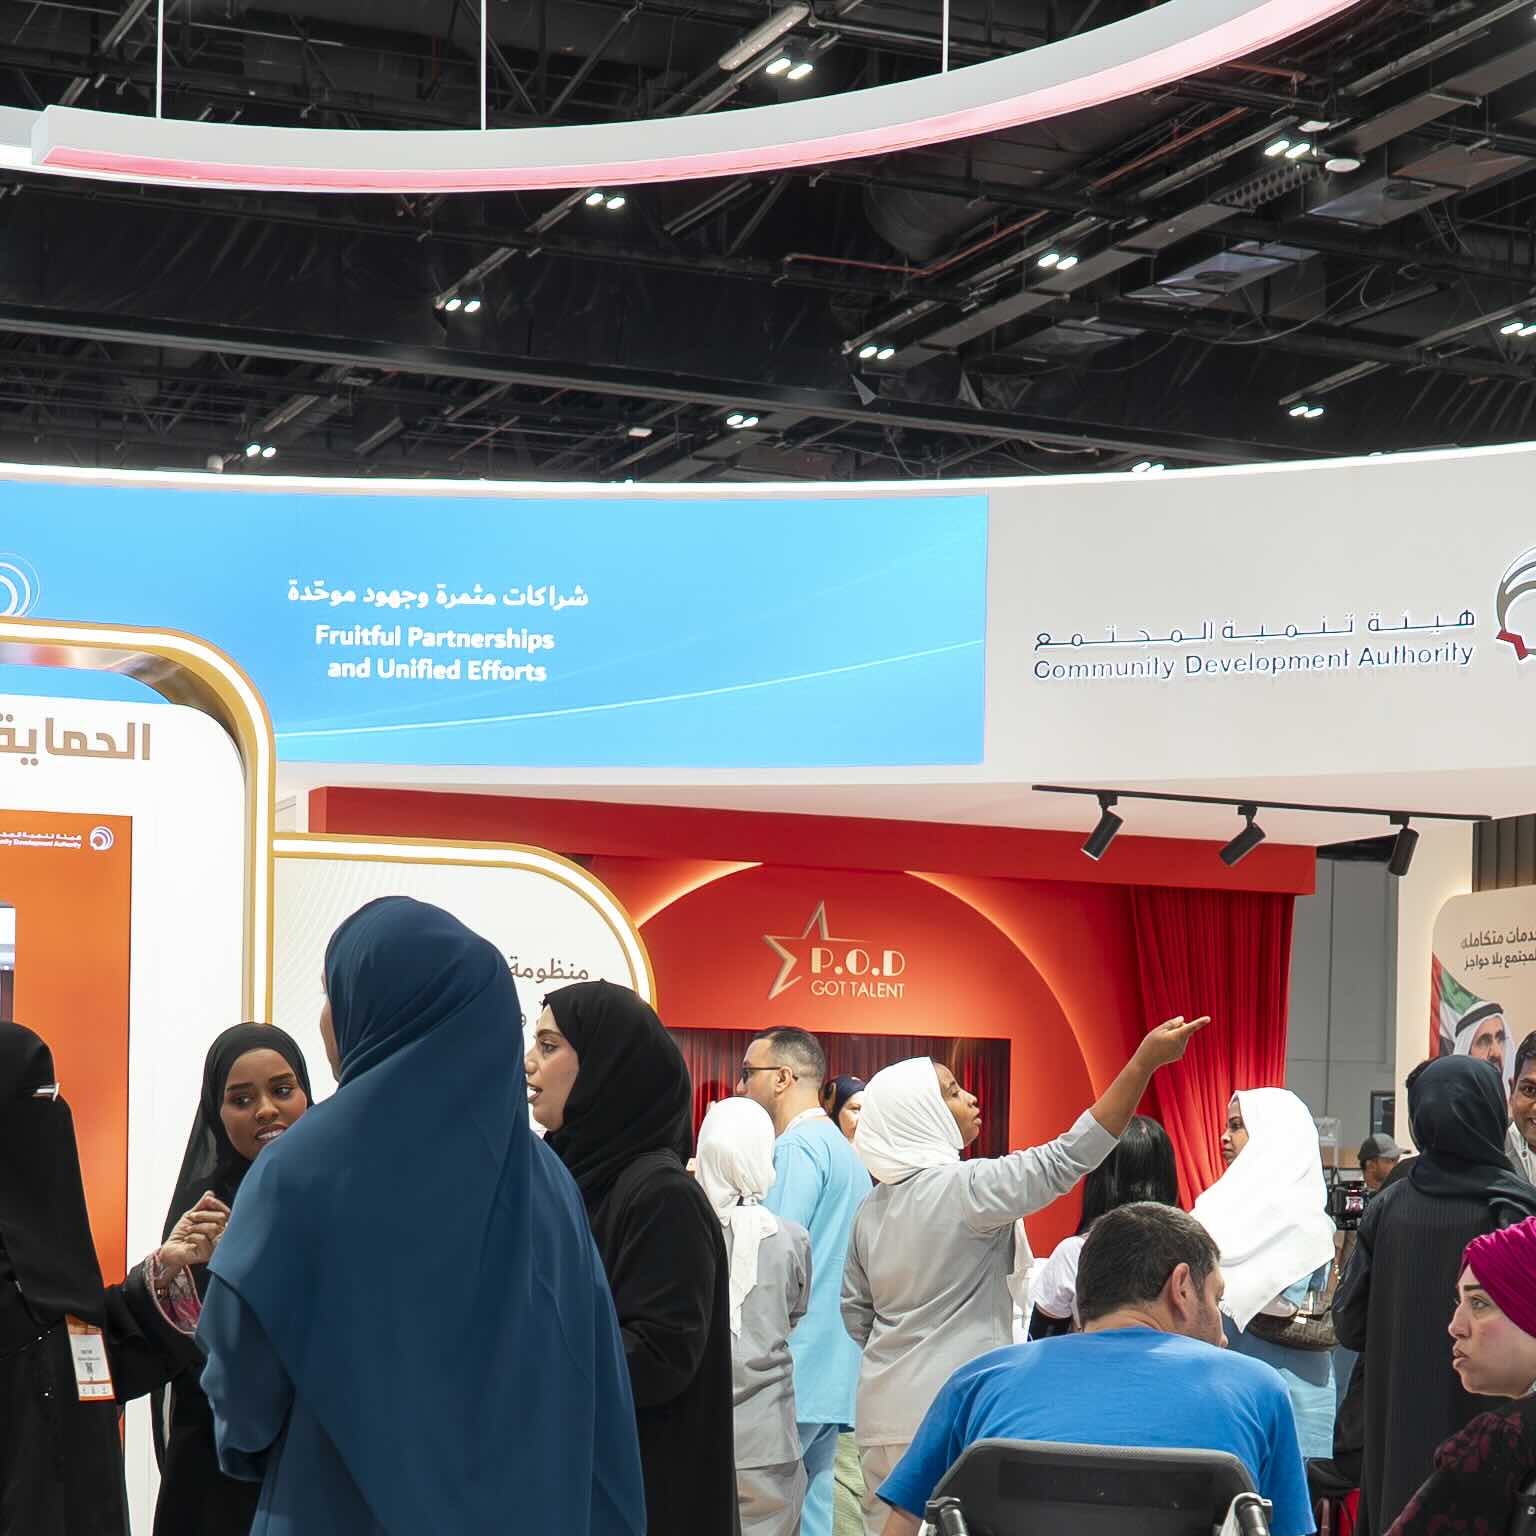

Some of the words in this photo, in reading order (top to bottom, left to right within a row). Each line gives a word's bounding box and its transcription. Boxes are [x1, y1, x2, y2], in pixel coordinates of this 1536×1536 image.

[363, 587, 429, 609] وجهود
[436, 583, 496, 609] مثمرة
[503, 584, 589, 611] شراكات
[1034, 621, 1214, 651] المجتمع
[1222, 614, 1354, 643] تنمية
[1368, 609, 1475, 638] هيئة
[315, 624, 401, 647] Fruitful
[407, 626, 555, 653] Partnerships
[327, 656, 371, 679] and
[377, 658, 461, 681] Unified
[467, 660, 547, 682] Efforts
[1033, 656, 1175, 680] Community
[1185, 649, 1351, 675] Development
[1358, 643, 1474, 667] Authority
[508, 956, 589, 983] منظومة
[811, 947, 906, 977] P.O.D
[1491, 952, 1503, 968] بلا
[811, 980, 845, 996] GOT
[850, 982, 904, 998] TALENT
